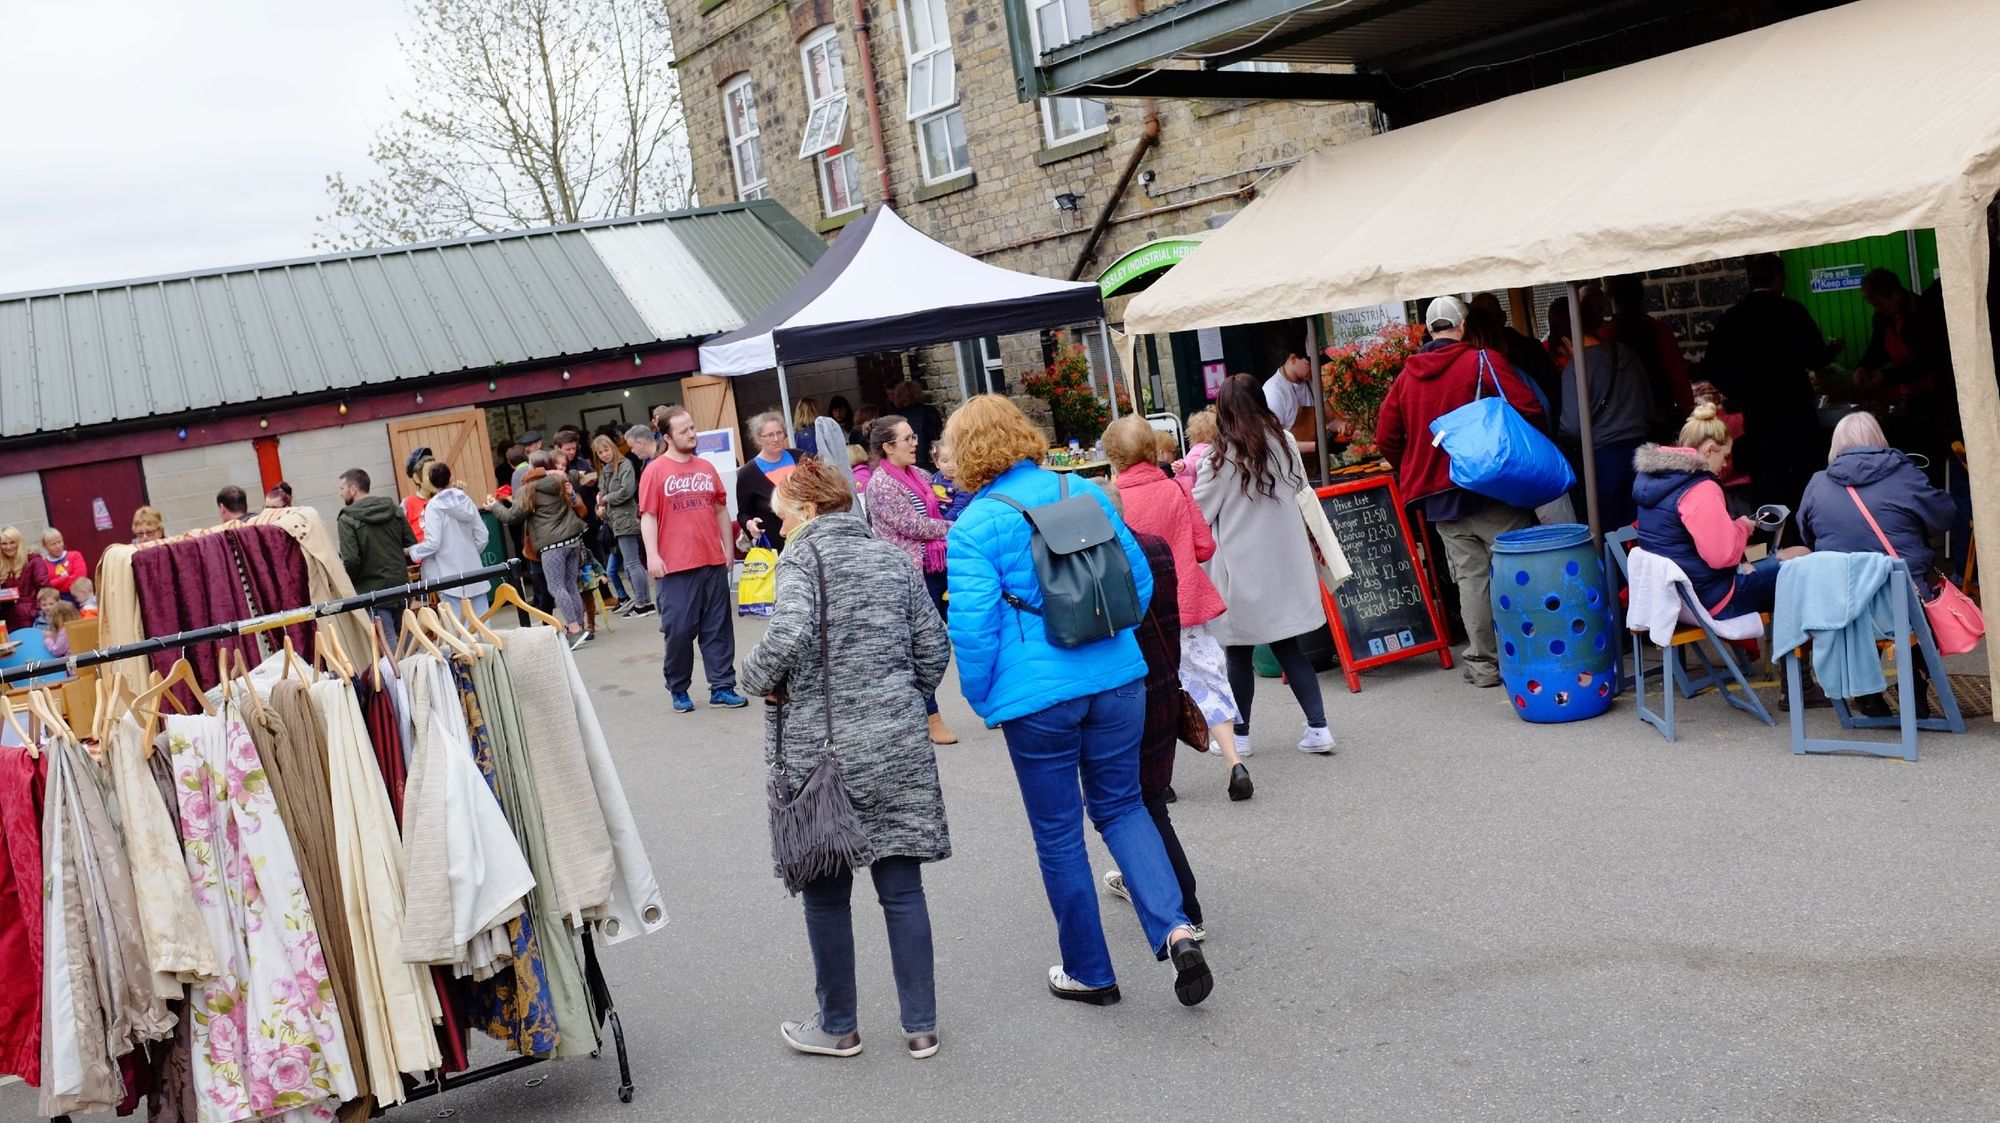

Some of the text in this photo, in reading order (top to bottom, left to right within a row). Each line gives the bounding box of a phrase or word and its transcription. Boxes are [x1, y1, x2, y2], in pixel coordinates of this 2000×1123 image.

[1127, 248, 1173, 272] INDUSTRIAL
[1820, 269, 1850, 279] Fire exit
[1821, 278, 1861, 289] Keep clear
[1338, 308, 1389, 324] INDUSTRIAL
[1332, 498, 1352, 512] Price
[1333, 507, 1388, 532] Burger £2.50
[1367, 523, 1397, 543] £2.50
[1361, 561, 1379, 577] hot
[1382, 560, 1410, 580] £2.00
[1363, 577, 1382, 590] dog
[1339, 588, 1377, 608] Chicken
[1356, 584, 1422, 619] Salad £2.50
